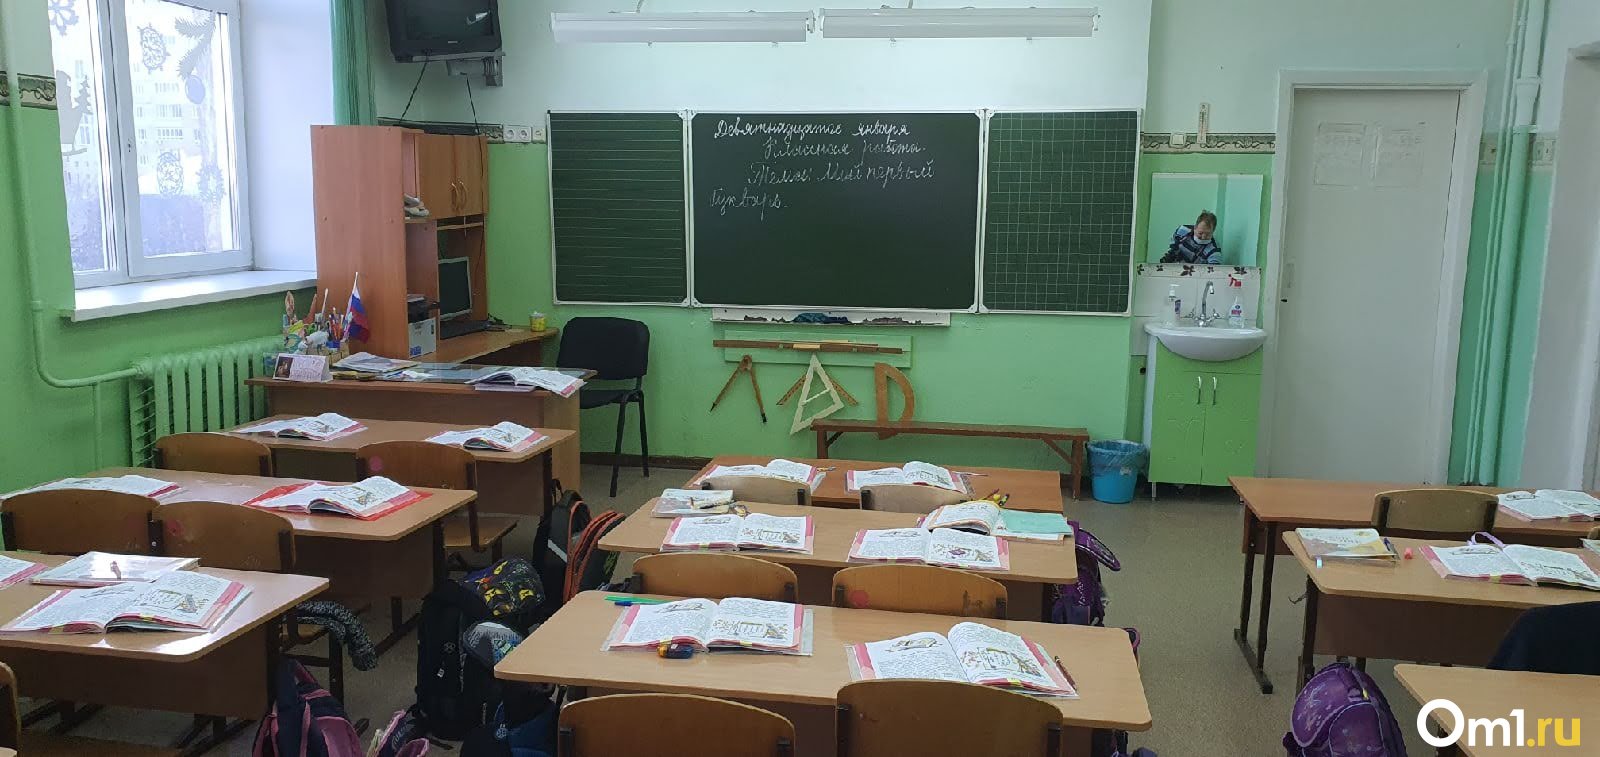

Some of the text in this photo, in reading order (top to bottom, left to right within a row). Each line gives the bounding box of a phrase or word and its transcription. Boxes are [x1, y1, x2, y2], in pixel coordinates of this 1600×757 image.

[714, 117, 910, 143] Девятнадцатое января
[763, 136, 851, 160] Классная
[816, 159, 864, 182] Мой
[866, 159, 935, 188] первый
